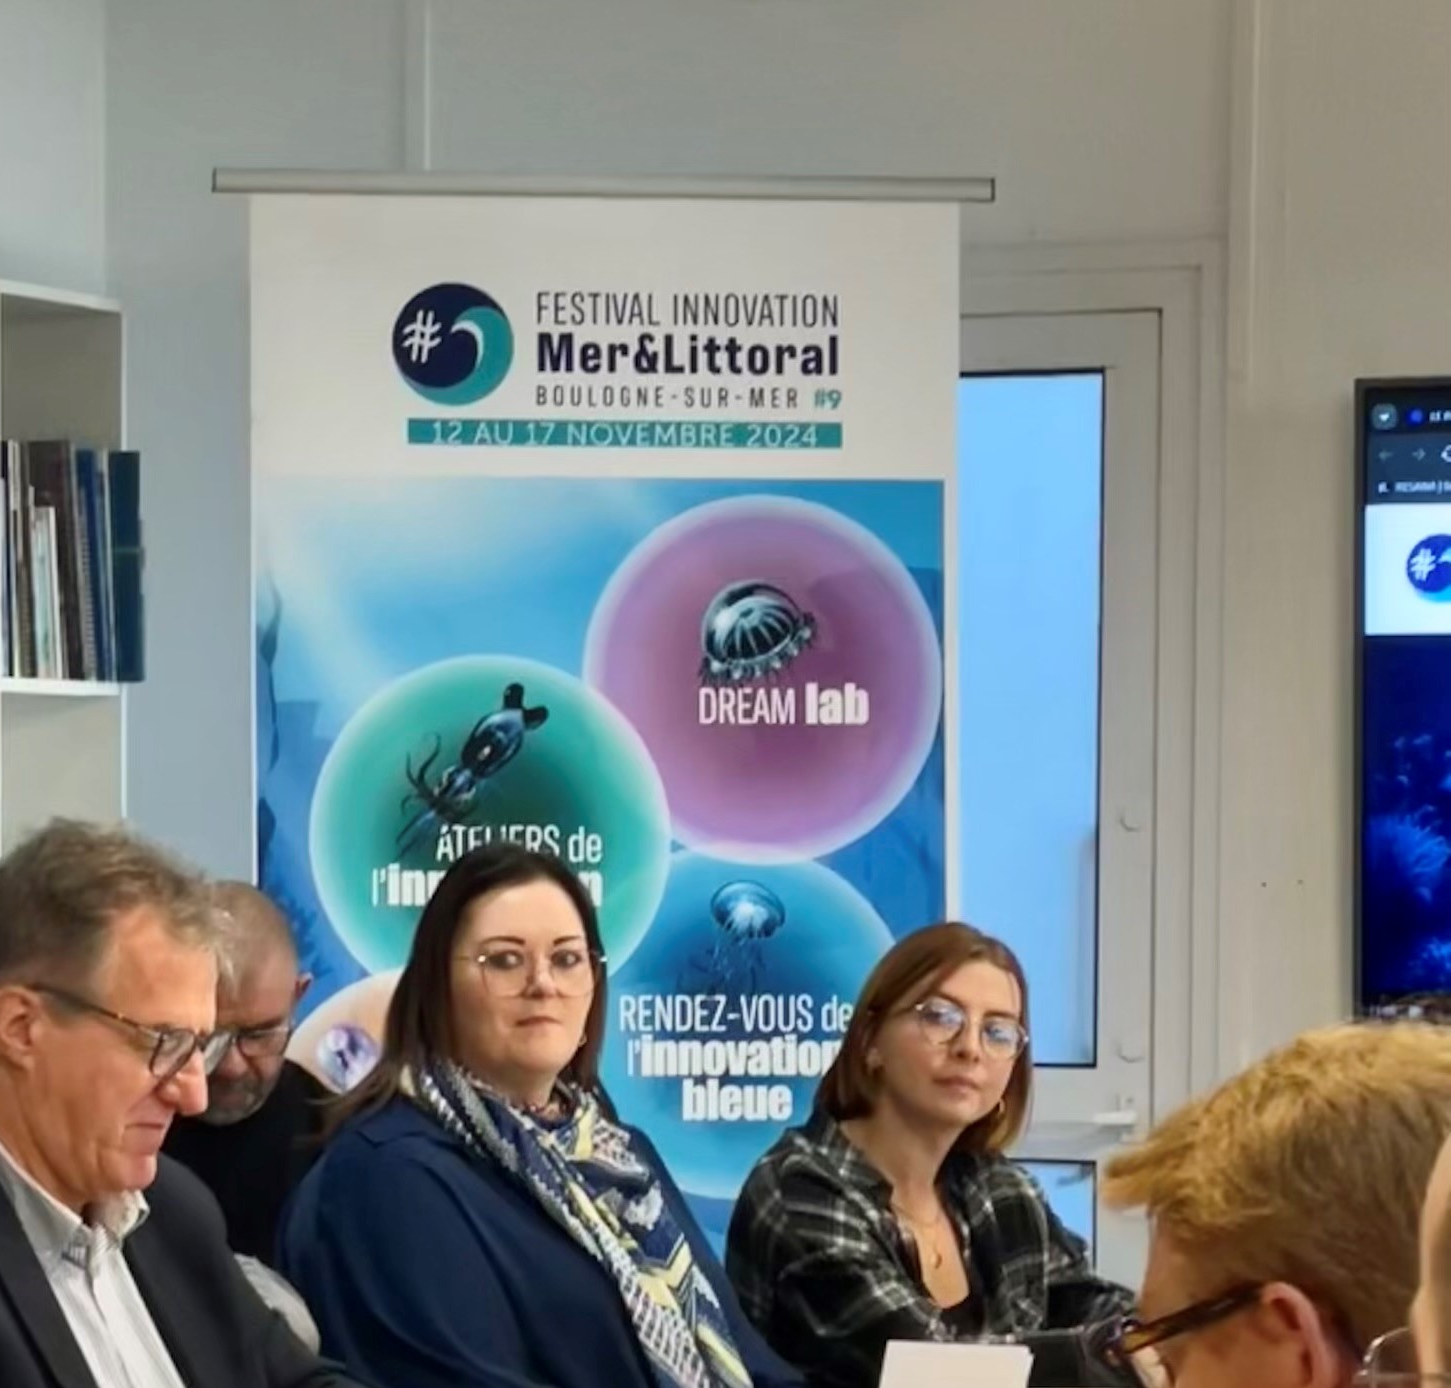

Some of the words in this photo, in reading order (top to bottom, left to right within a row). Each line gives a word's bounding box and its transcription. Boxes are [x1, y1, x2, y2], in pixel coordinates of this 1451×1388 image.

[536, 291, 660, 326] FESTIVAL
[672, 293, 839, 328] INNOVATION
[537, 331, 839, 376] Mer&Littoral
[535, 384, 799, 409] BOULOGNE-SUR-MER
[813, 389, 843, 410] #9
[433, 421, 463, 444] 12
[474, 421, 513, 445] AU
[525, 421, 556, 446] 17
[566, 421, 735, 447] NOVEMBRE
[745, 423, 818, 447] 2024
[699, 686, 796, 725] DREAM
[805, 682, 870, 725] lab
[568, 825, 604, 864] de
[619, 994, 814, 1033] RENDEZ-VOUS
[821, 994, 854, 1033] de
[682, 1078, 794, 1121] bleue
